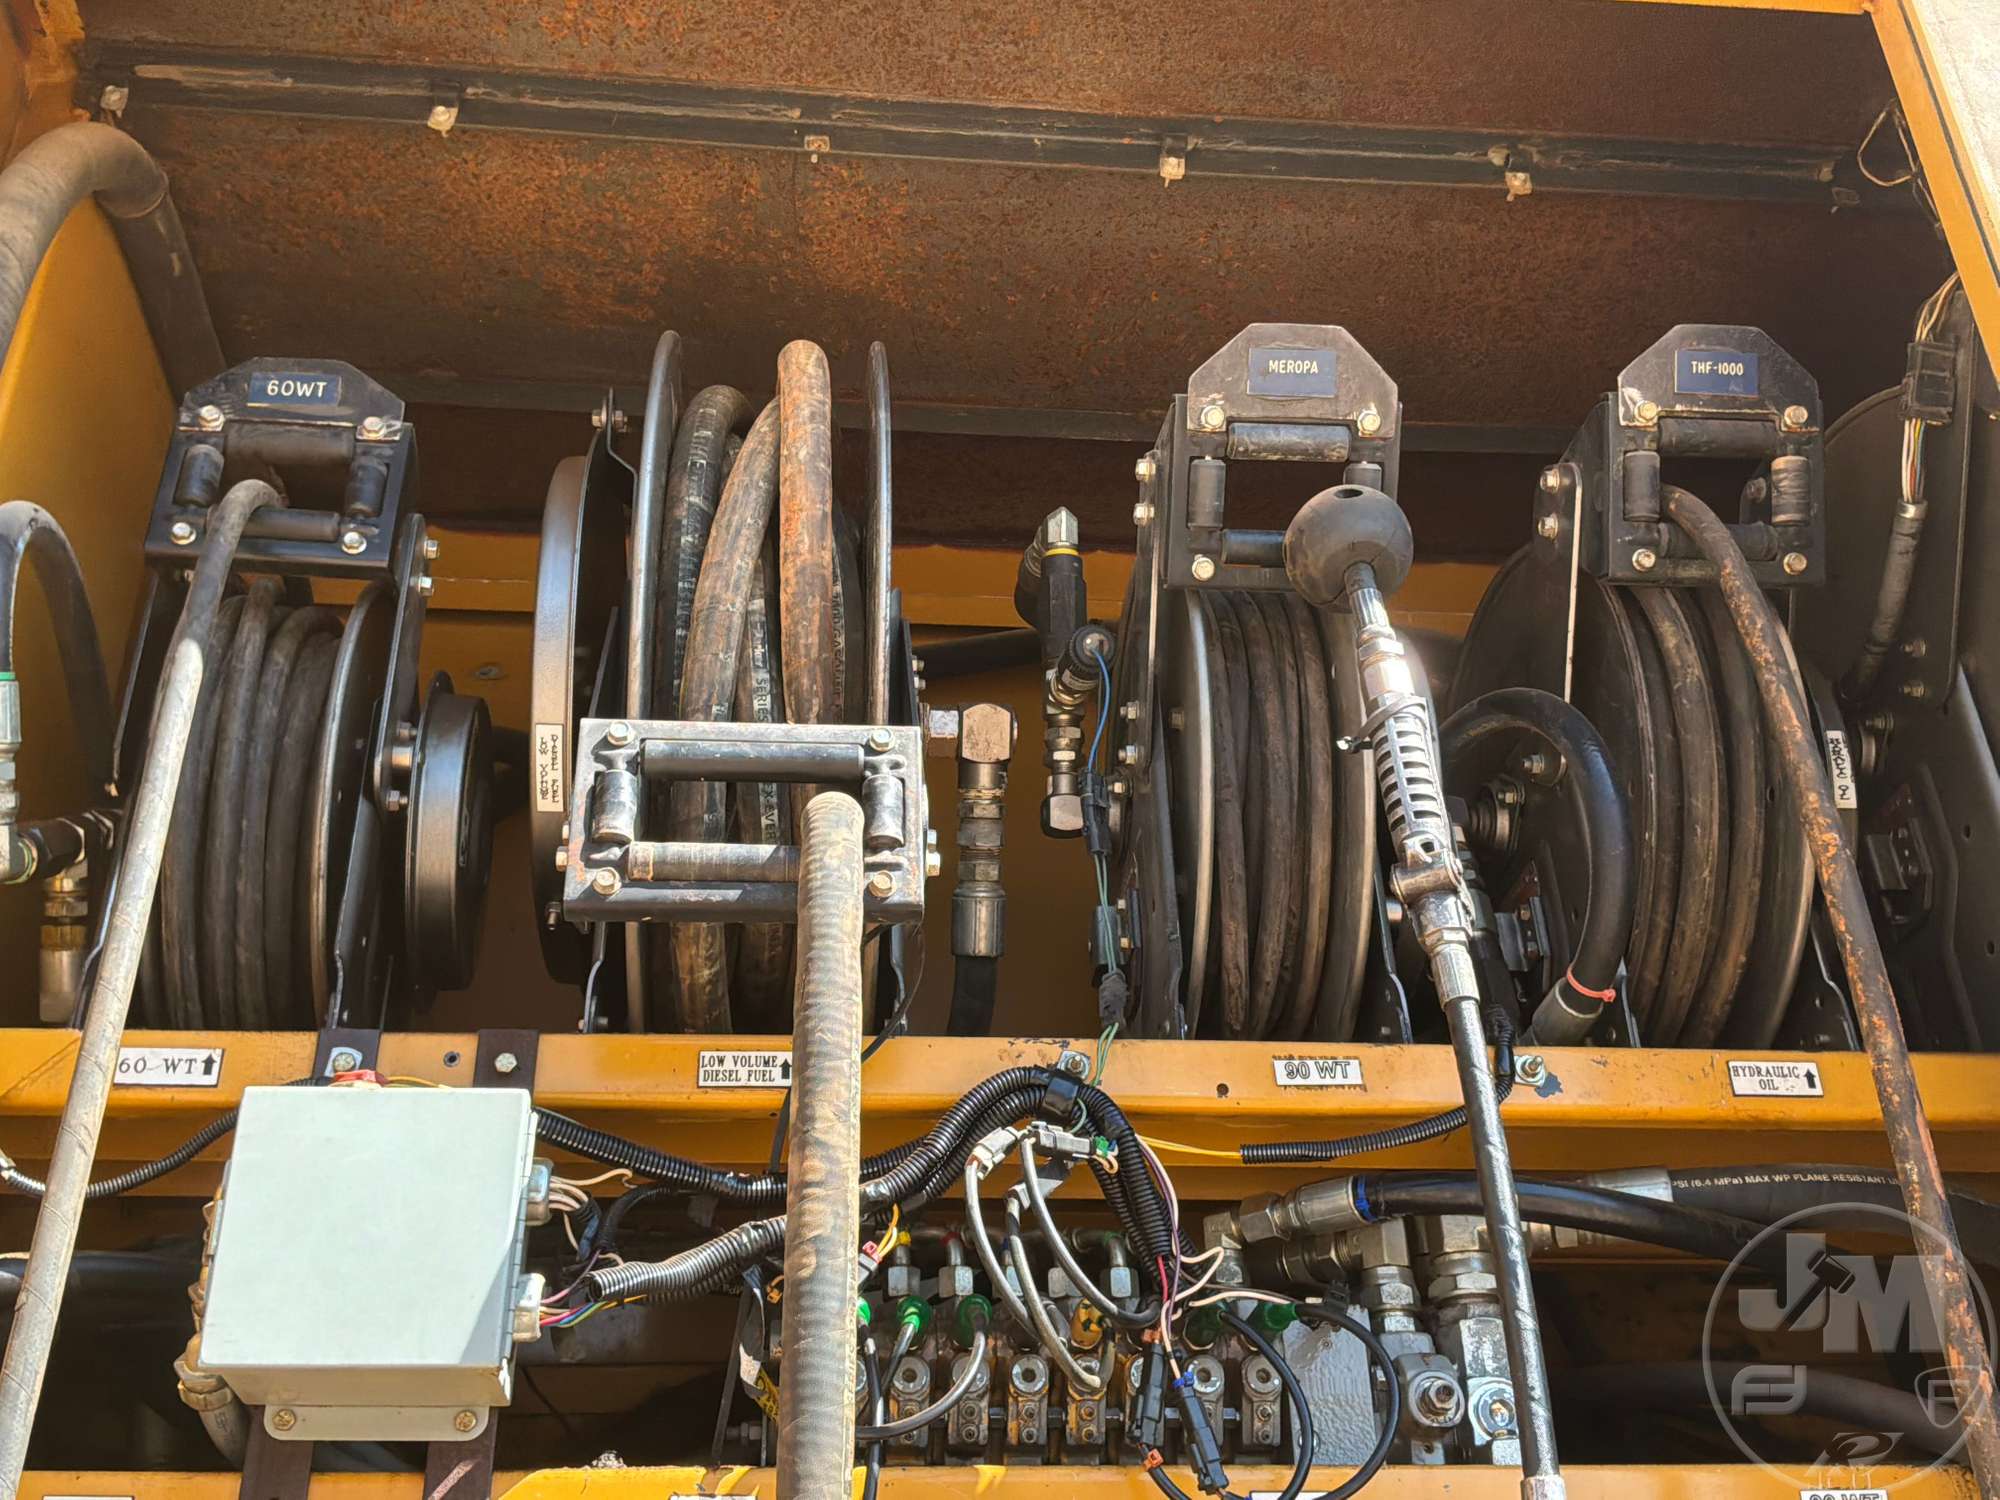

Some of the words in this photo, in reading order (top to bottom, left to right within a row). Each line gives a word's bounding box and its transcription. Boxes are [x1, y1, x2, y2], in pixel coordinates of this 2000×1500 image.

[1268, 359, 1320, 375] MEROPA
[1690, 360, 1745, 377] THF-1000
[266, 379, 329, 399] 60WT
[755, 678, 769, 722] SERIES
[118, 1057, 147, 1075] 60
[163, 1057, 199, 1076] WT
[701, 1055, 726, 1069] LOW
[732, 1055, 778, 1069] VOLUME
[703, 1069, 742, 1083] DIESEL
[747, 1069, 776, 1083] FUEL
[1284, 1061, 1311, 1080] 90
[1314, 1061, 1351, 1080] WT
[1731, 1064, 1801, 1080] HYDRAULIC
[1758, 1078, 1780, 1091] OIL
[1744, 1174, 1771, 1185] MAX
